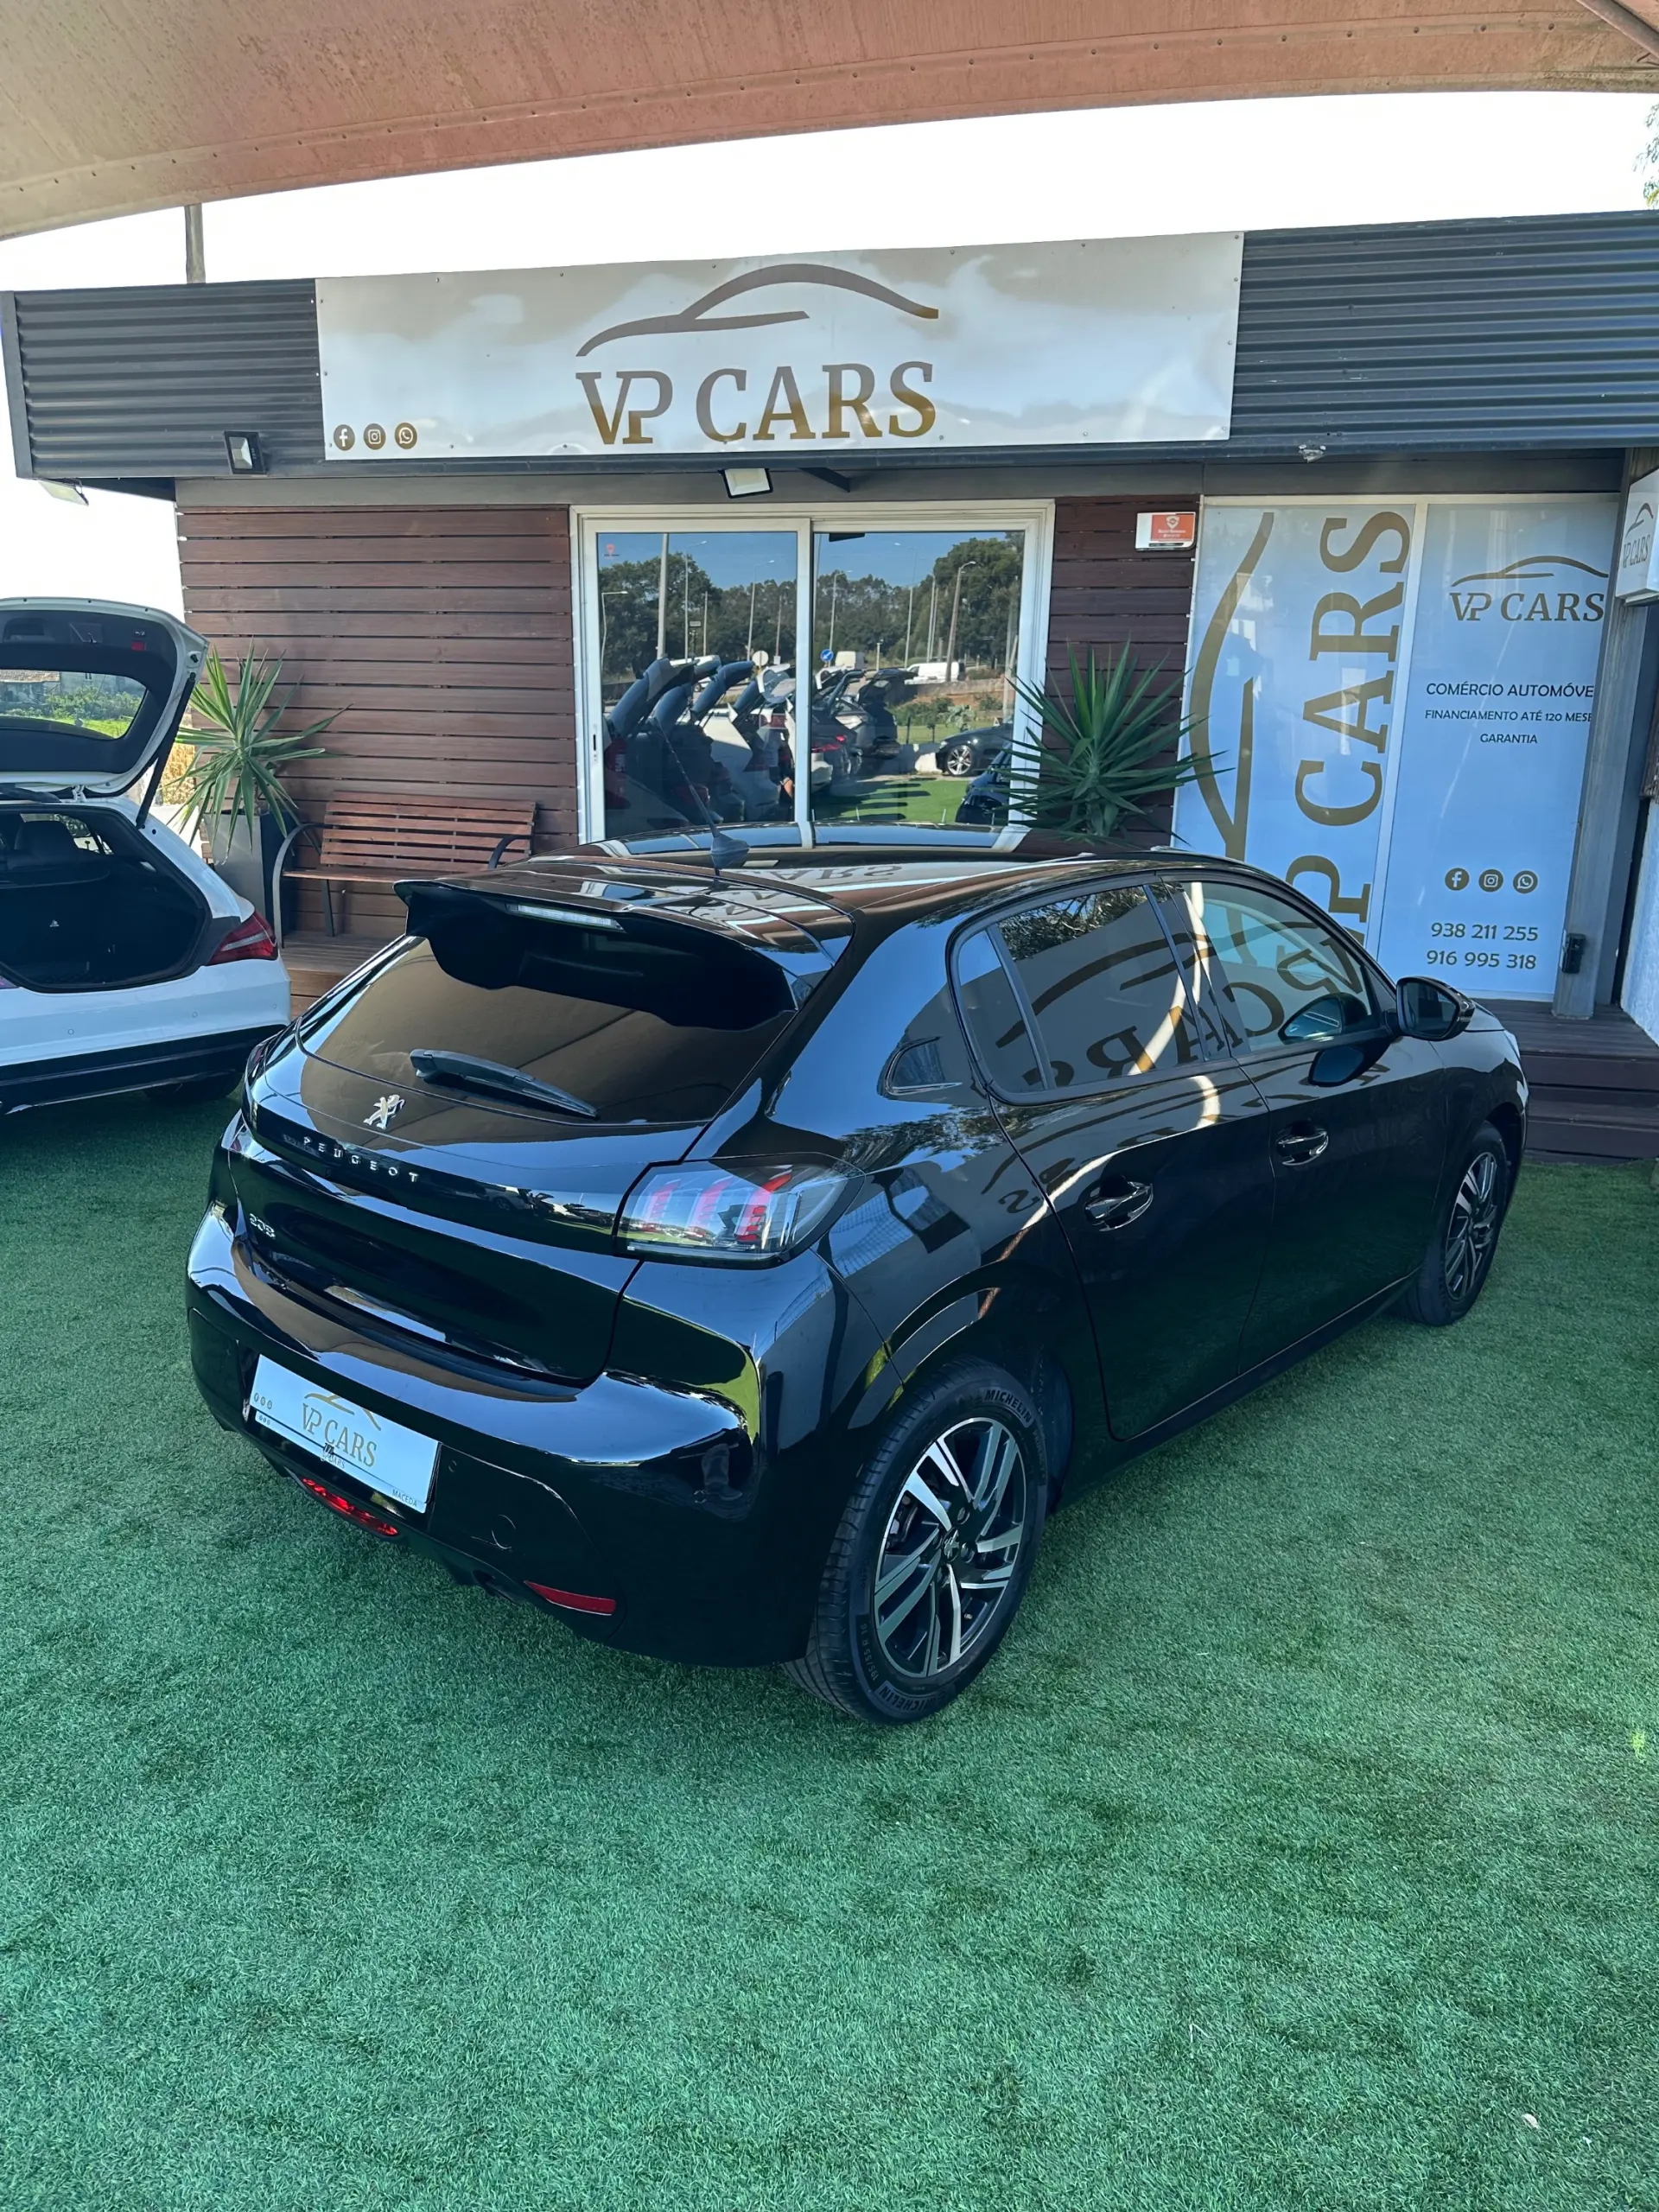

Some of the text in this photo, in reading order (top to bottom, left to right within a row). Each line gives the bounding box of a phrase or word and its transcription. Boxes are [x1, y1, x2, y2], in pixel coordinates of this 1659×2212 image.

[576, 361, 937, 445] VP CARS
[1630, 534, 1650, 566] CARS
[1449, 592, 1605, 621] VP CARS
[1426, 681, 1594, 697] COMÉRCIO AUTOMÓVE
[1286, 511, 1411, 949] P CARS
[1425, 709, 1593, 722] FINANCIAMENTO ATÉ 120 MESE
[1479, 734, 1538, 744] GARANTIA
[1431, 922, 1538, 941] 938 211 255
[1426, 950, 1536, 969] 916 995 318
[302, 1135, 420, 1183] PEUGEOT
[984, 1389, 1033, 1423] MICHELIN
[302, 1402, 378, 1468] VP CARS
[392, 1488, 418, 1508] MACEDA
